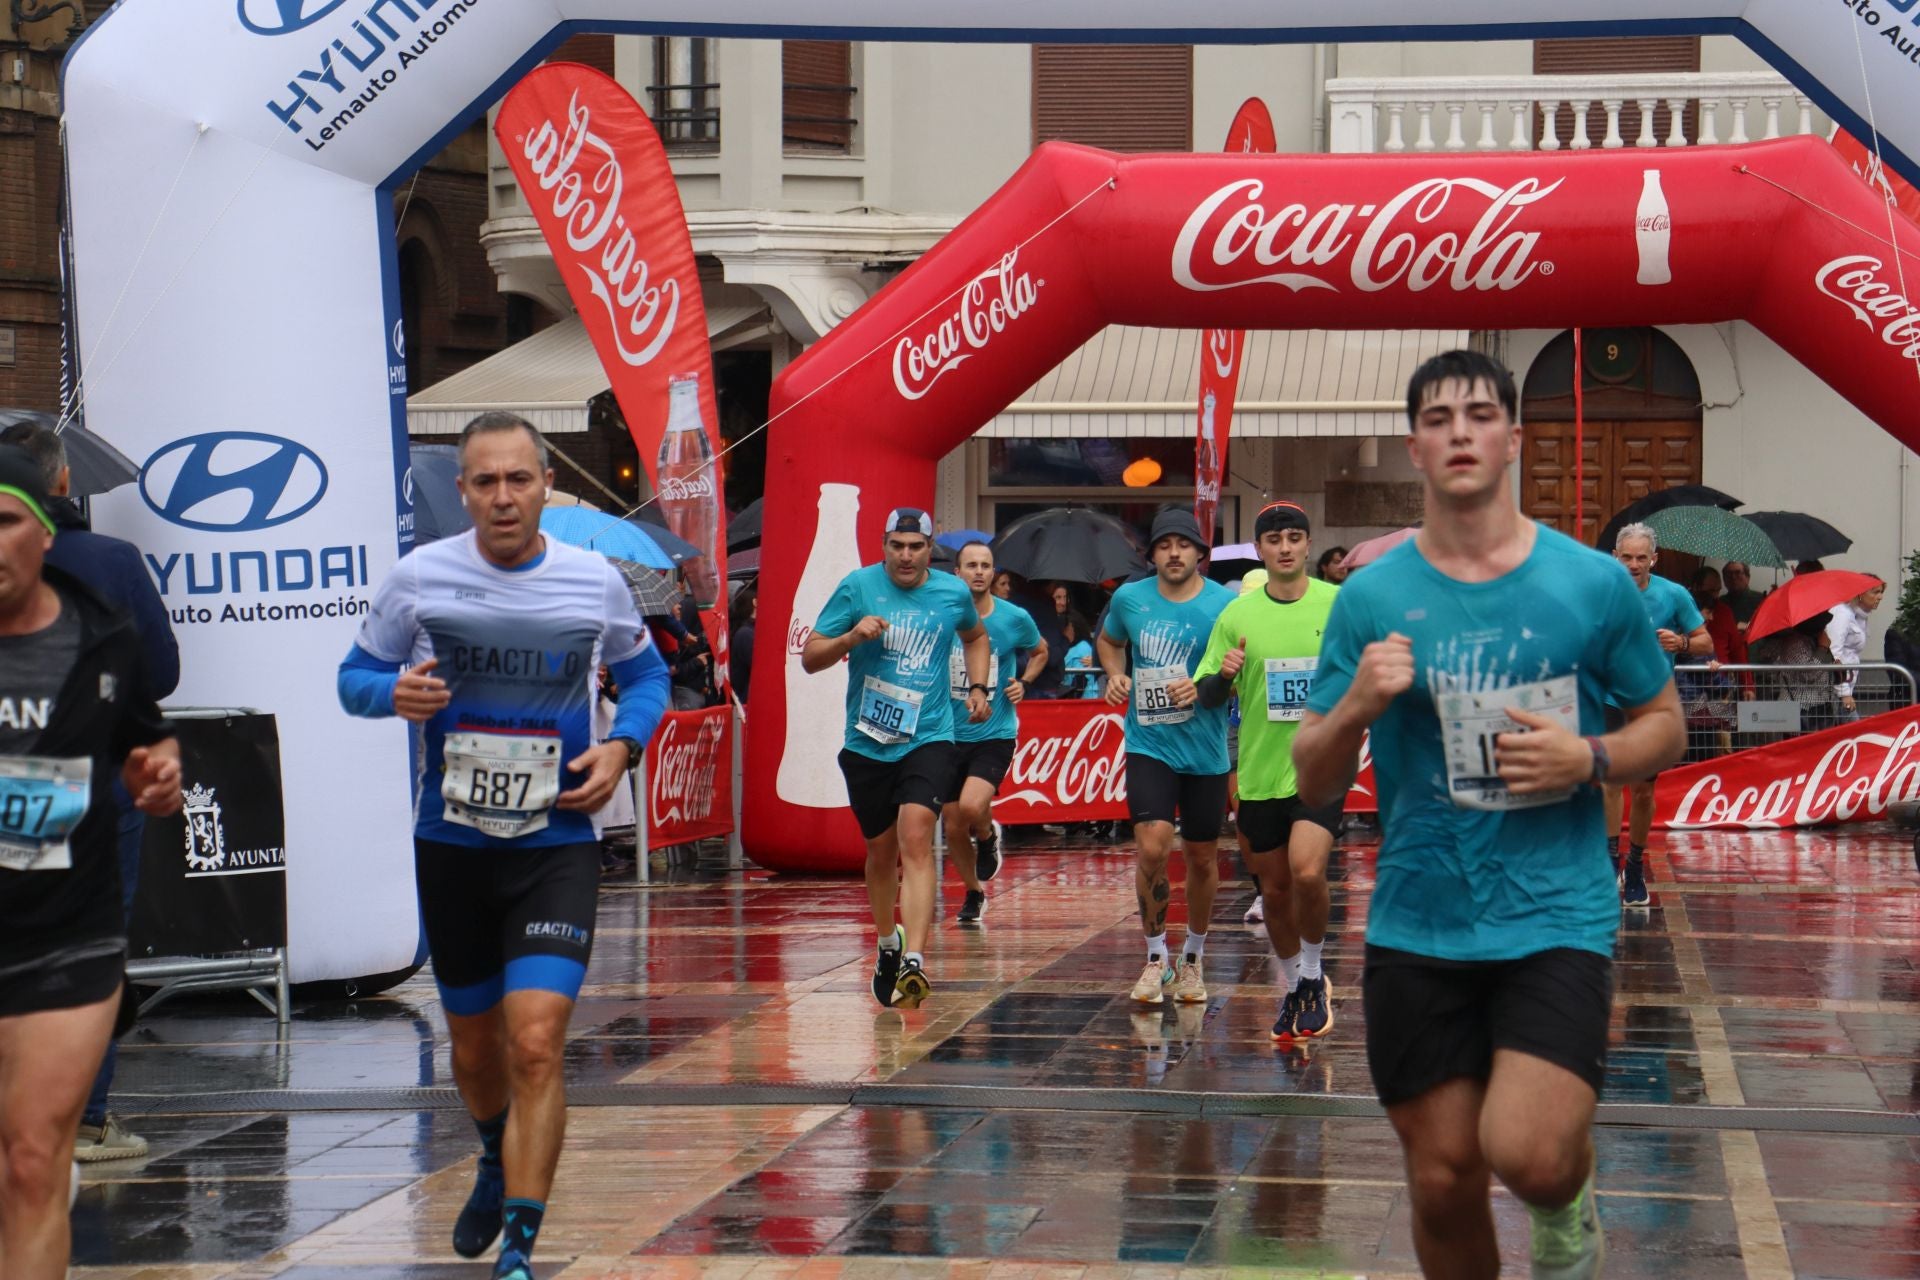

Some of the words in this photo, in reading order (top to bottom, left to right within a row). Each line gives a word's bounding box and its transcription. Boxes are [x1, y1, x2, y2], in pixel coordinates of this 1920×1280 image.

[266, 0, 438, 134] HYUN
[304, 68, 397, 152] Lemauto
[1170, 176, 1567, 294] Coca-Cola
[892, 244, 1038, 400] Coca-Cola
[1607, 344, 1618, 361] 9
[145, 544, 368, 596] YUNDAI
[220, 595, 369, 623] Automoción
[454, 645, 580, 679] CEACTIVO
[871, 699, 905, 730] 509
[1145, 687, 1172, 709] 86
[469, 768, 532, 809] 687
[525, 921, 589, 945] CEACTIVO
